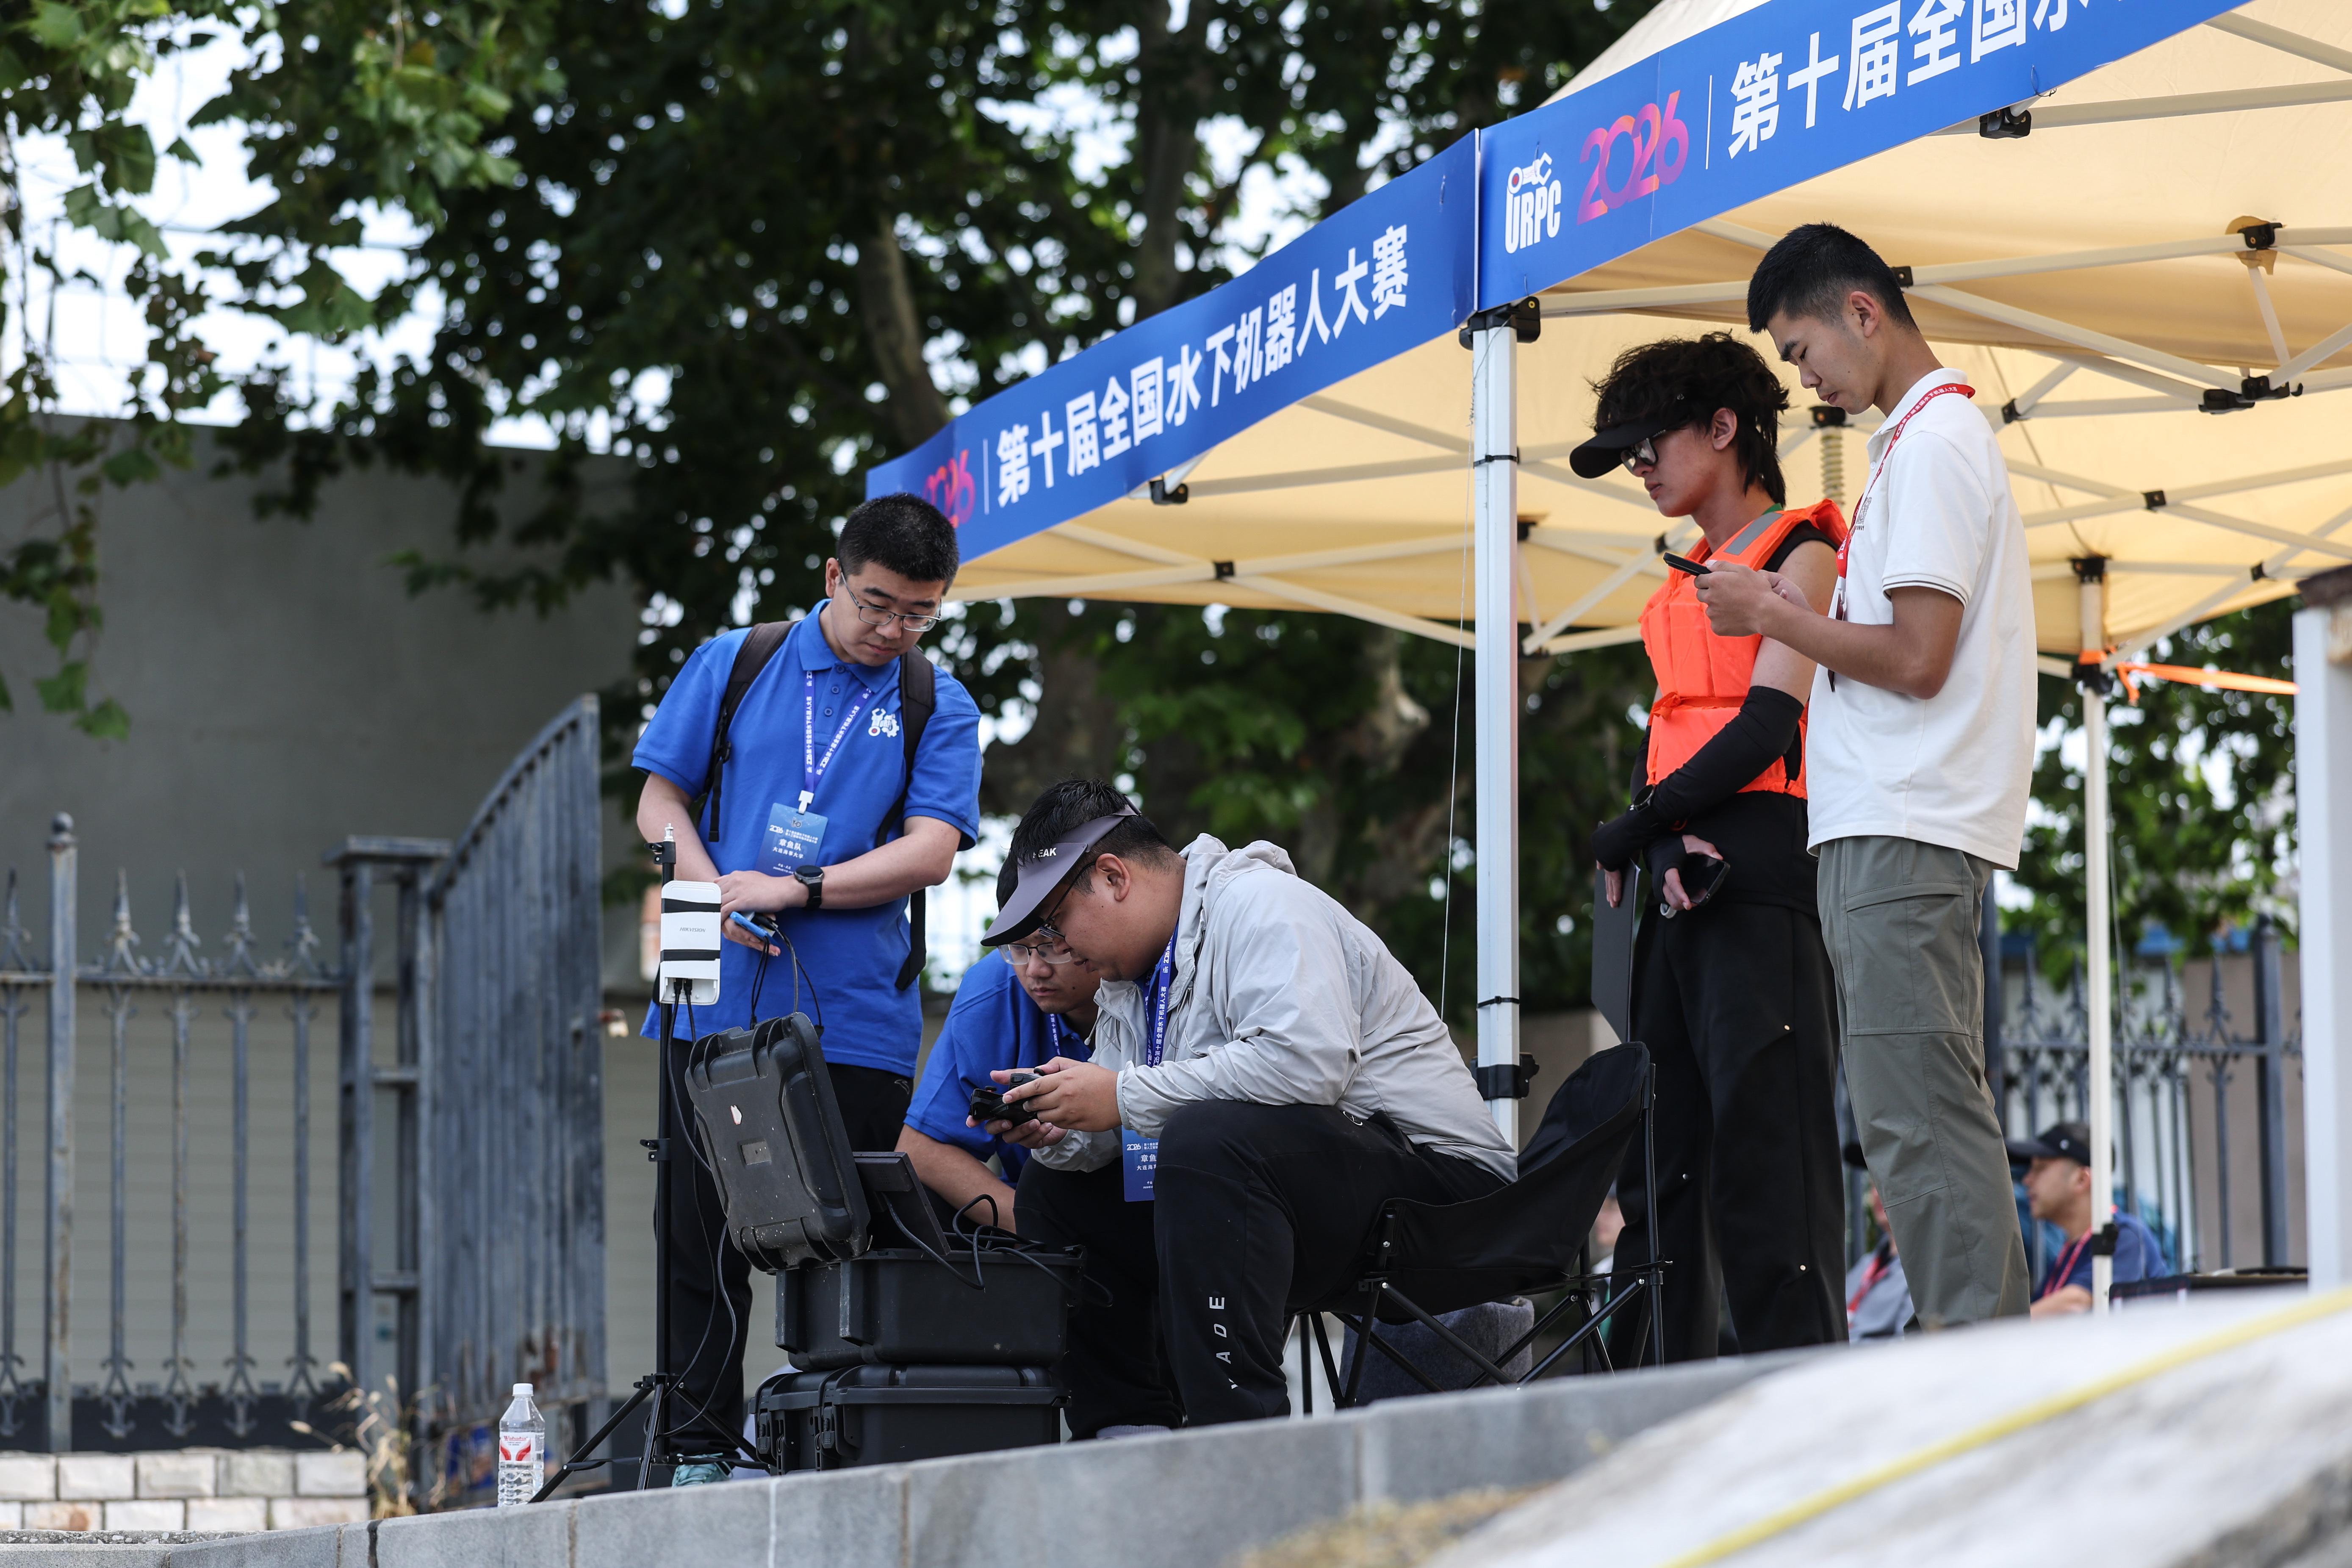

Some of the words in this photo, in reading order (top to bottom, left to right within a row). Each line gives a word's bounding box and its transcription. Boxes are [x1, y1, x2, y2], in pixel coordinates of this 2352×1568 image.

[1505, 180, 1562, 254] URPC
[1577, 89, 1689, 225] 2026
[996, 224, 1408, 508] 第十届全国水下机器人大赛
